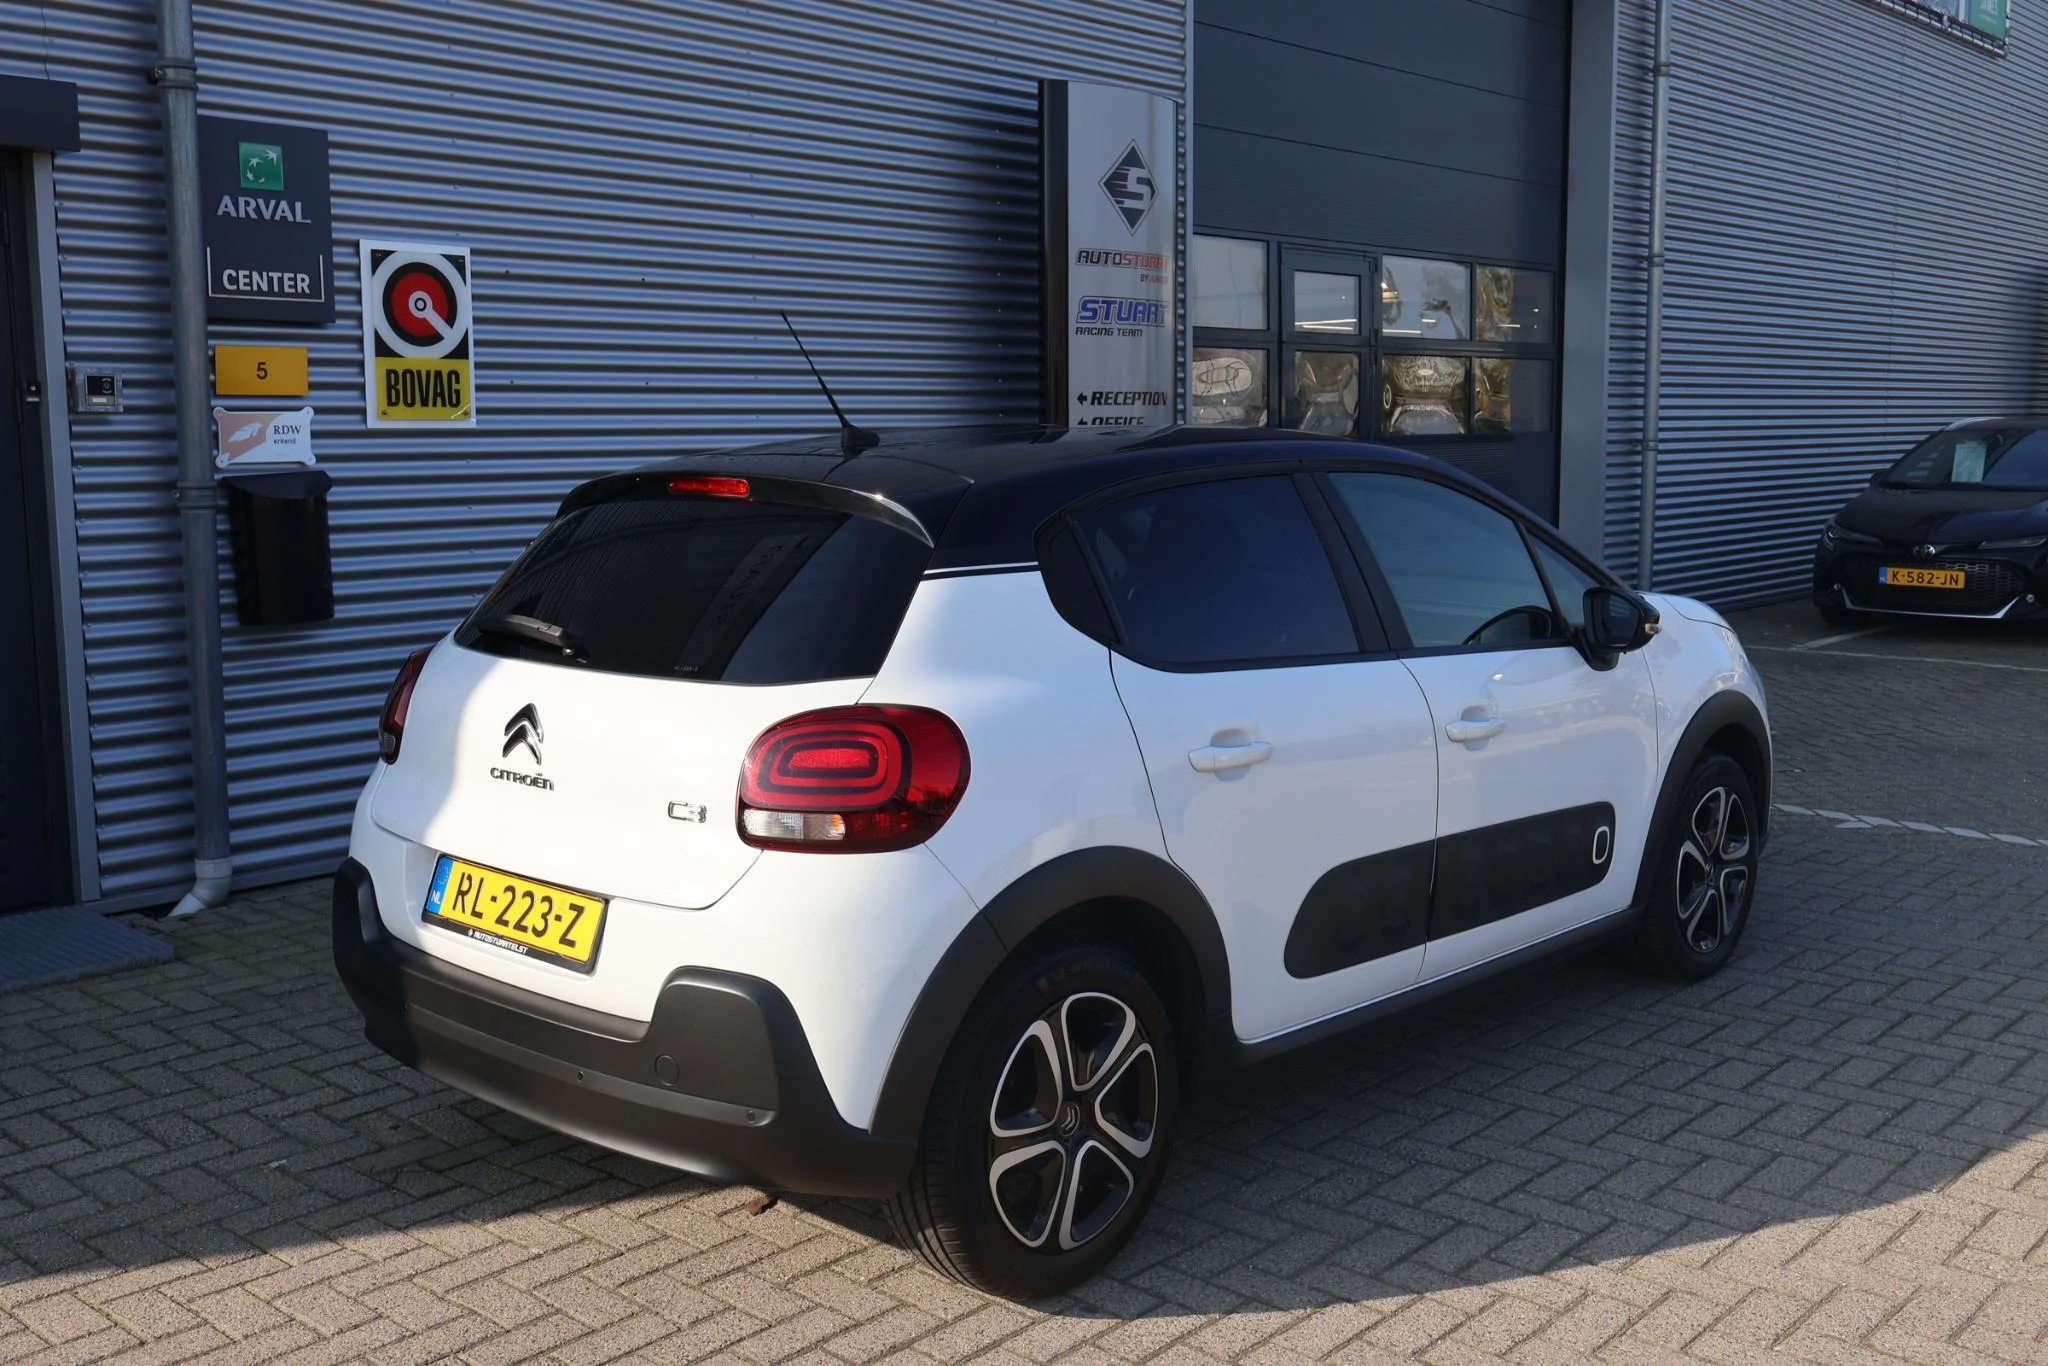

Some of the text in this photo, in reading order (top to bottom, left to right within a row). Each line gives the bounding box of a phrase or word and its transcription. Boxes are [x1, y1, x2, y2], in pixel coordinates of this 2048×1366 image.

[216, 194, 312, 224] ARVAL
[222, 268, 311, 294] CENTER
[1075, 326, 1142, 337] RACING TEAM
[256, 361, 268, 380] 5
[385, 368, 461, 408] BOVAG
[1090, 391, 1168, 406] RECEPTION
[273, 424, 302, 435] RDW
[1891, 570, 1959, 586] K-582-JN
[668, 801, 708, 823] C3
[431, 890, 441, 905] NL
[452, 871, 585, 949] RL-223-Z
